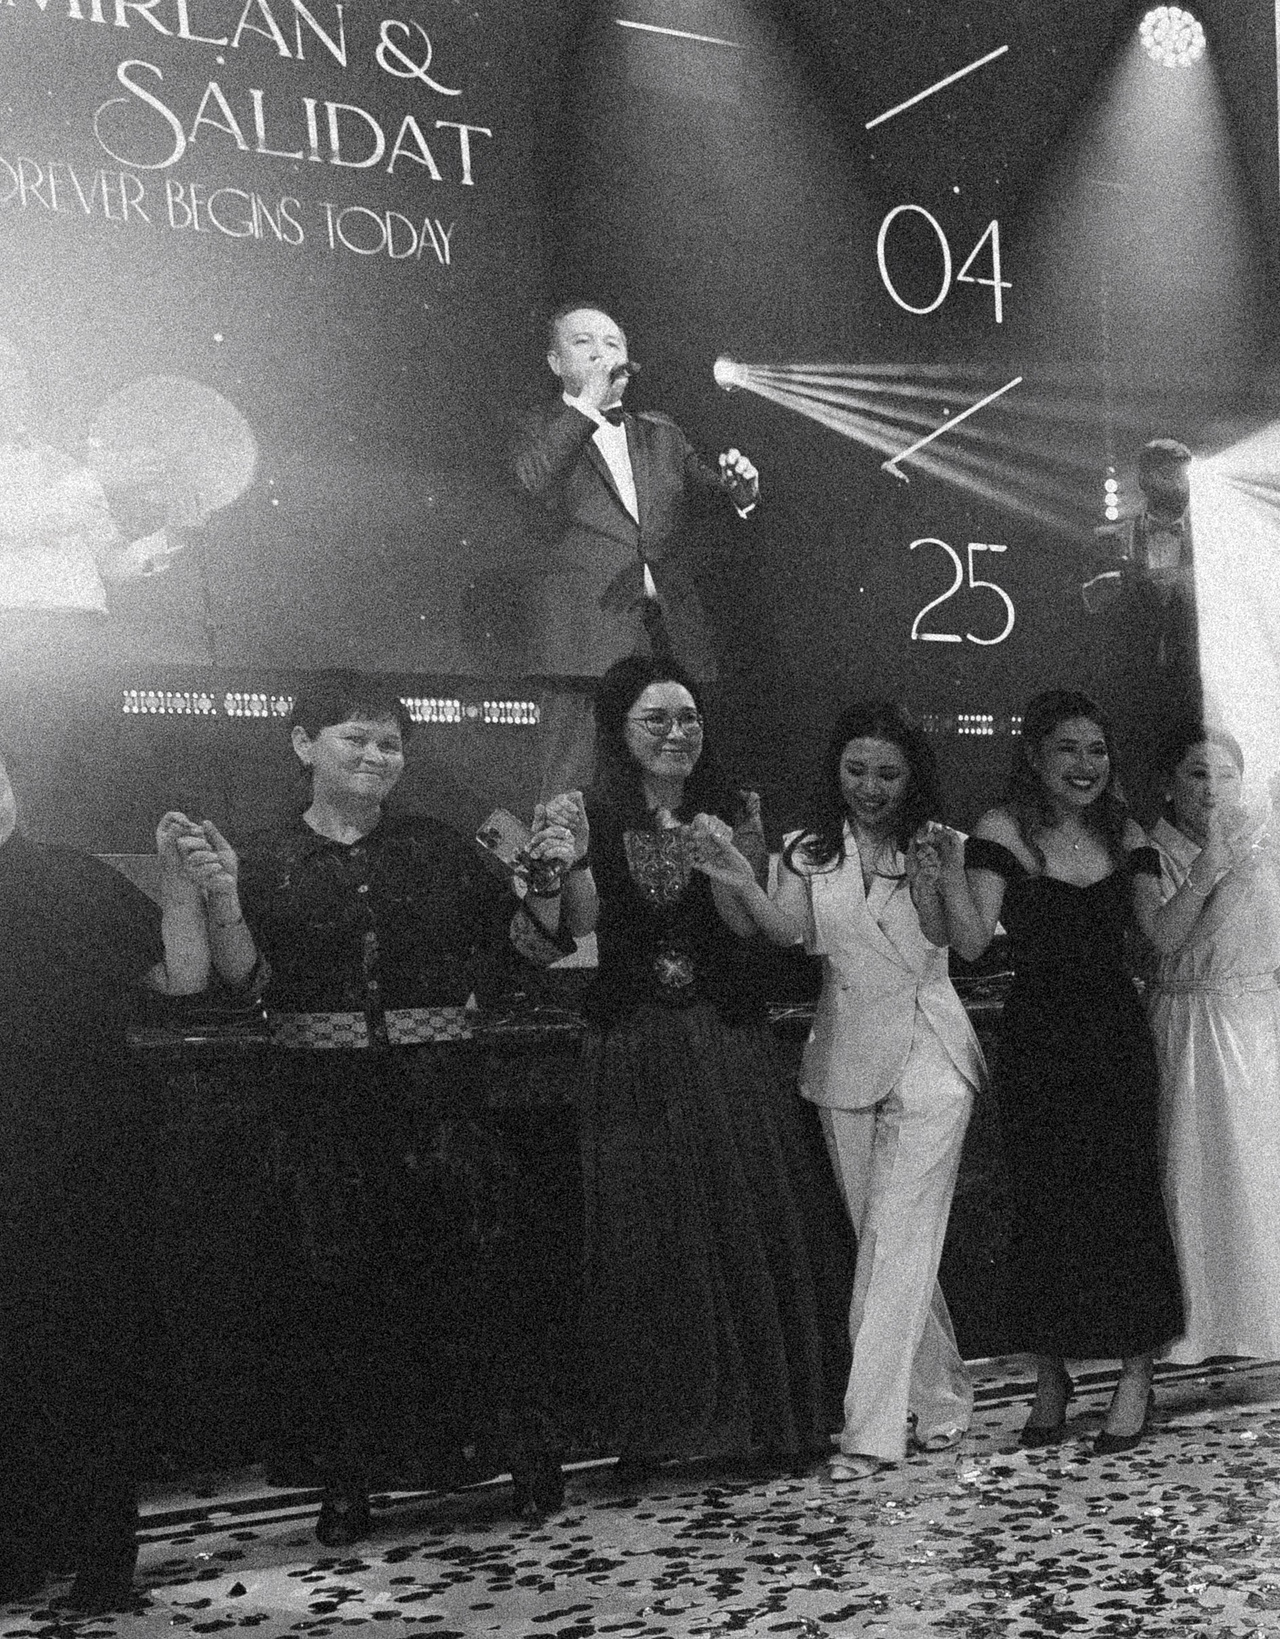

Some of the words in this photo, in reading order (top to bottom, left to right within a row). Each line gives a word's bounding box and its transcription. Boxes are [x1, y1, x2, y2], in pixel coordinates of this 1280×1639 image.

[375, 19, 462, 96] &
[94, 59, 492, 186] SALIDAT
[166, 179, 305, 246] BEGINS
[318, 202, 456, 266] TODAY
[876, 204, 1012, 323] 04
[909, 538, 1014, 645] 25
